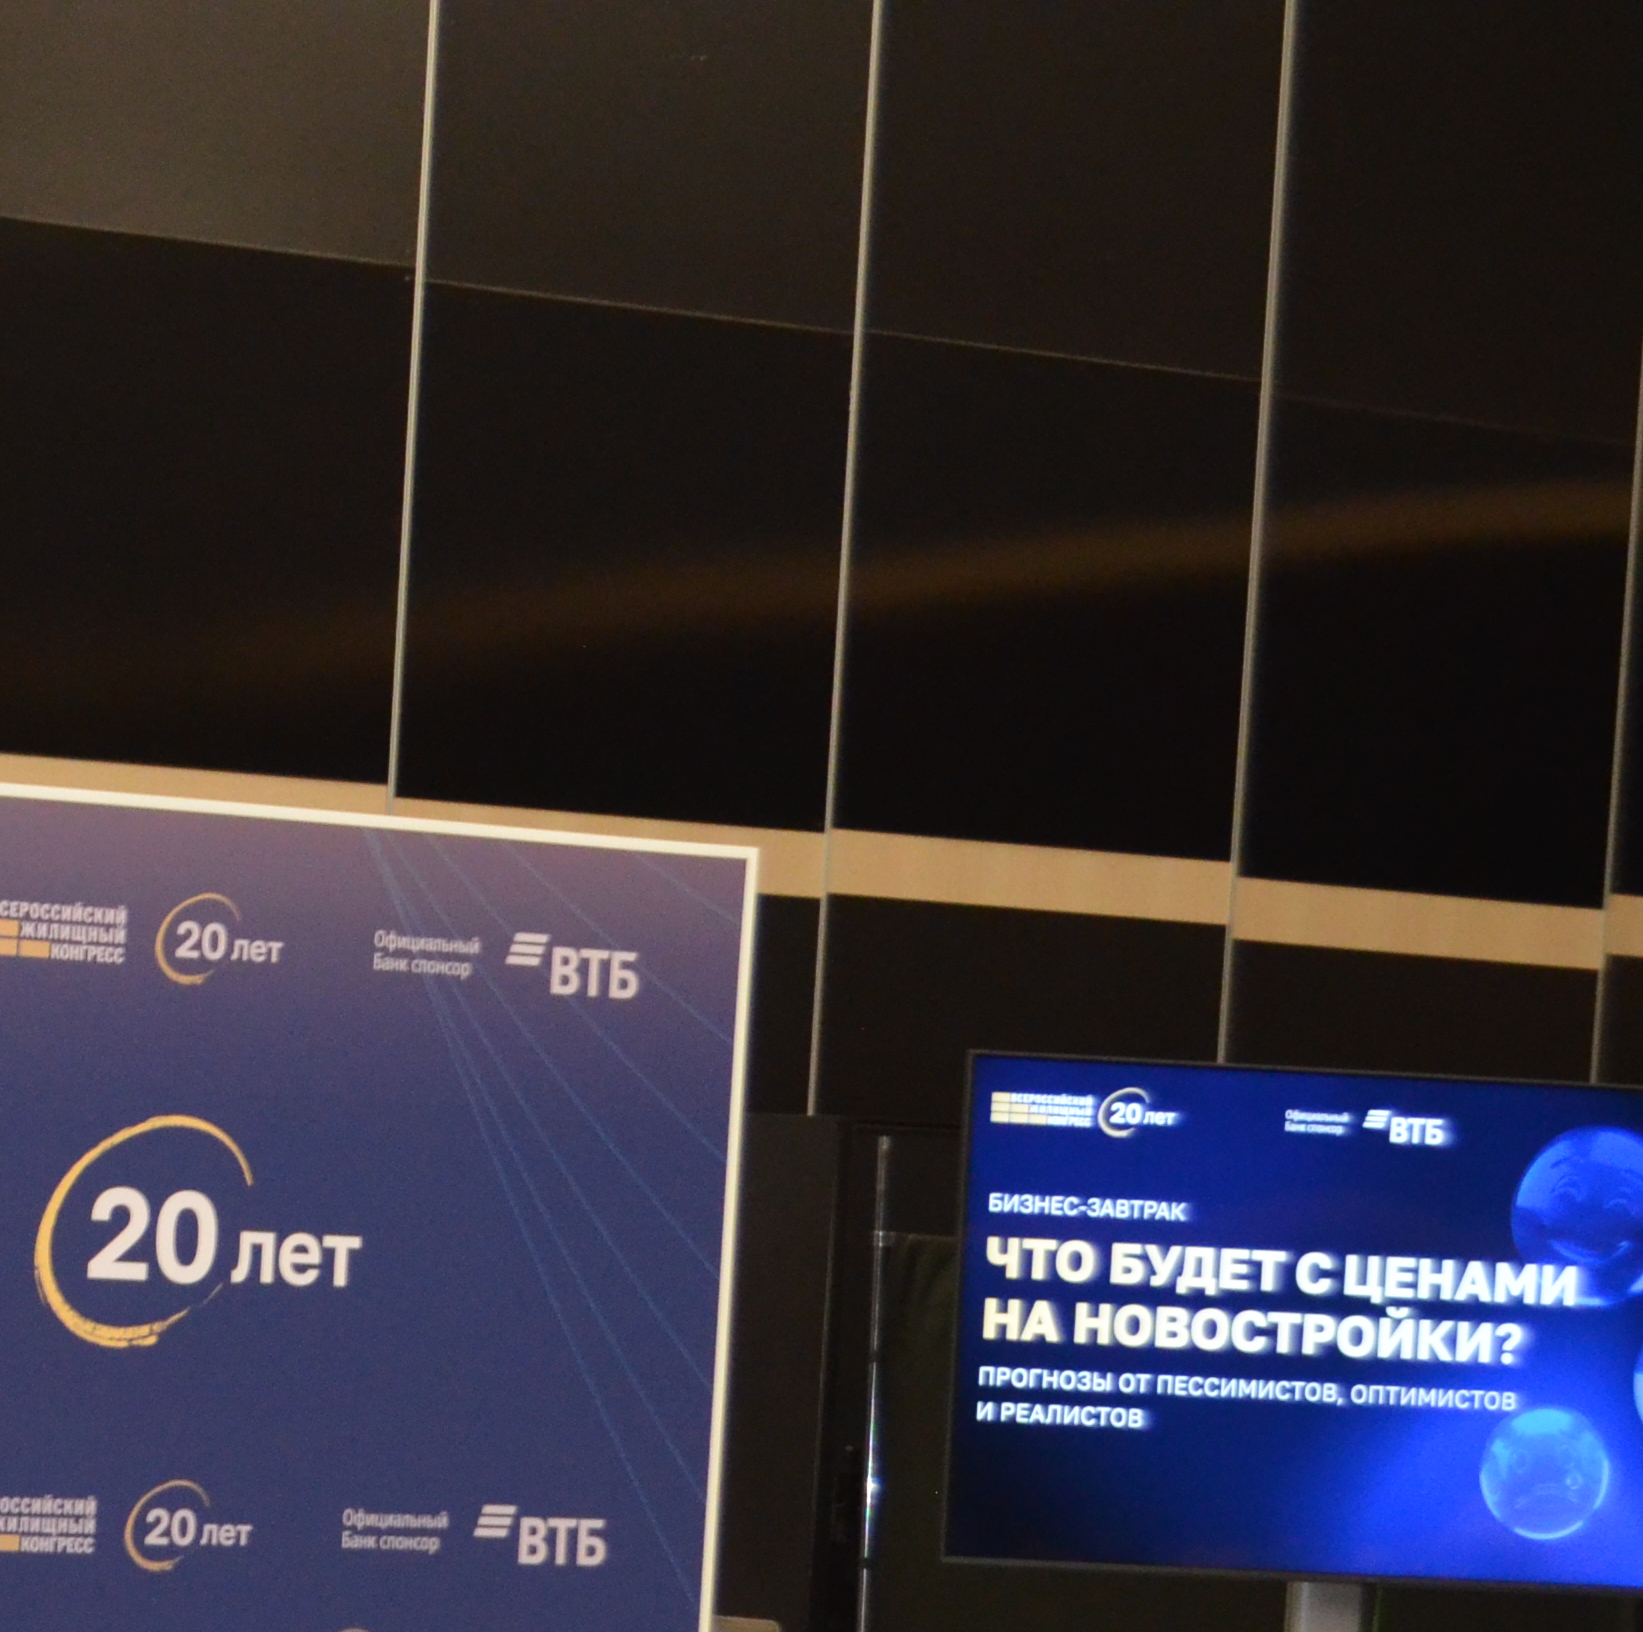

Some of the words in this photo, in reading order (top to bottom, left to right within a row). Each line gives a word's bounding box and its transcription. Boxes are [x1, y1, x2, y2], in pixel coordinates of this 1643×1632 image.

[19, 919, 128, 945] ЖИЛИЩНЫЙ
[174, 919, 229, 961] 20
[231, 936, 284, 965] лет
[372, 928, 481, 956] Официальный
[50, 941, 126, 965] КОНГРЕСС
[372, 951, 406, 974] Банк
[410, 957, 472, 981] спонсор
[549, 946, 640, 999] ВТБ
[1109, 1102, 1143, 1125] 20
[1143, 1110, 1178, 1127] лет
[1389, 1116, 1446, 1146] ВТБ
[987, 1191, 1189, 1223] БИЗНЕС-ЗАВТРАК
[86, 1184, 220, 1286] 20
[230, 1226, 363, 1290] лет
[986, 1235, 1095, 1283] ЧТО
[1109, 1242, 1285, 1295] БУДЕТ
[1295, 1251, 1340, 1295] С
[1343, 1253, 1579, 1307] ЦЕНАМИ
[982, 1296, 1061, 1342] НА
[1073, 1301, 1523, 1365] НОВОСТРОЙКИ?
[977, 1365, 1112, 1393] ПРОГНОЗЫ
[1117, 1371, 1152, 1396] ОТ
[1156, 1373, 1345, 1406] ПЕССИМИСТОВ,
[1349, 1383, 1517, 1412] ОПТИМИСТОВ
[976, 1401, 995, 1422] И
[999, 1402, 1145, 1429] РЕАЛИСТОВ
[144, 1507, 197, 1547] 20
[200, 1520, 254, 1548] лет
[341, 1507, 450, 1533] Официальный
[19, 1533, 96, 1555] КОНГРЕСС
[341, 1529, 378, 1550] Банк
[380, 1532, 441, 1555] спонсор
[517, 1515, 608, 1567] ВТБ
